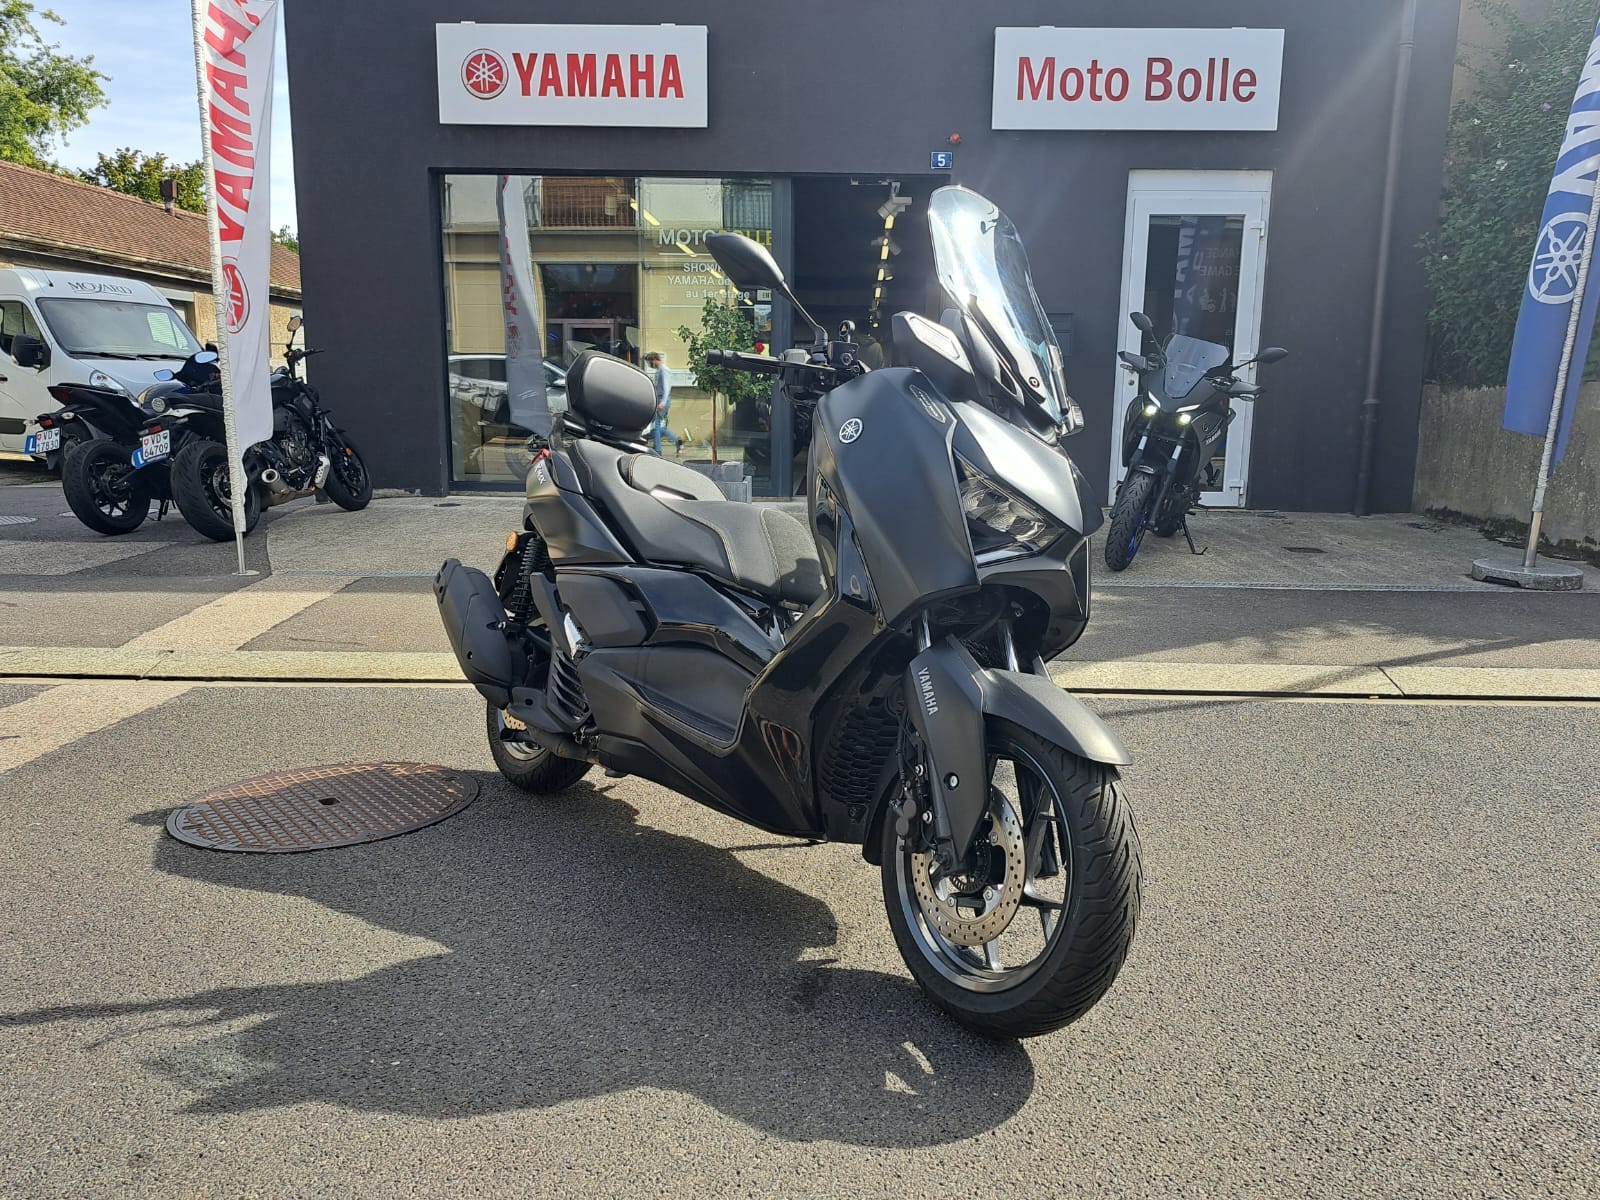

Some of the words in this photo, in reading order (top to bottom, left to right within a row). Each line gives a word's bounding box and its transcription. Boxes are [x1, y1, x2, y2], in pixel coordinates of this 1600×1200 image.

[512, 52, 684, 98] YAMAHA
[1016, 56, 1129, 102] Moto
[1145, 57, 1257, 102] Bolle
[937, 153, 946, 167] 5
[668, 275, 714, 286] YAMAHA
[43, 430, 53, 441] VD
[151, 433, 161, 445] VD
[144, 442, 168, 458] 64709
[918, 666, 939, 716] YAMAHA
